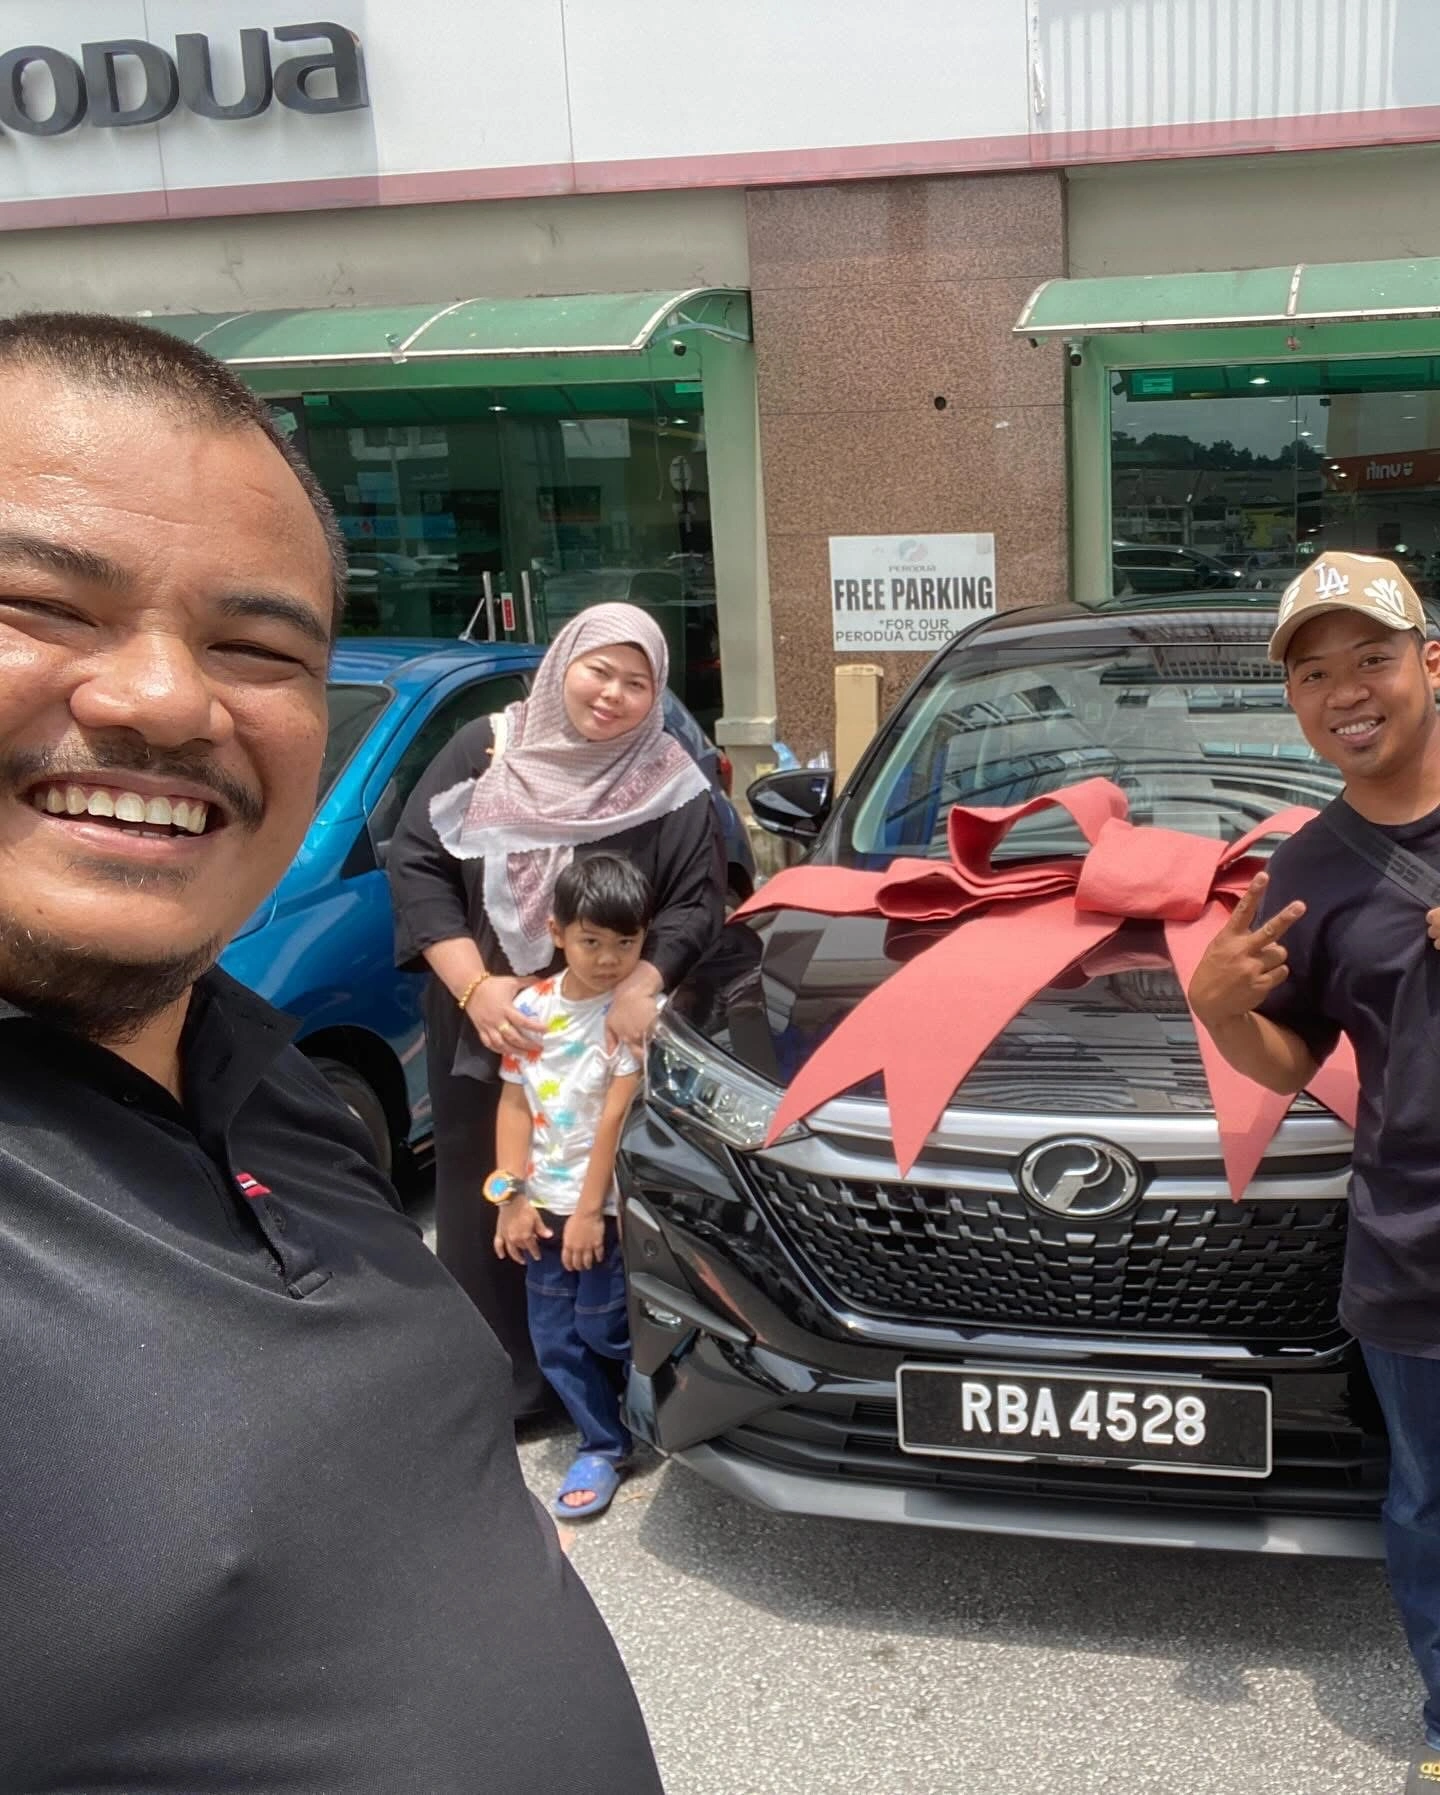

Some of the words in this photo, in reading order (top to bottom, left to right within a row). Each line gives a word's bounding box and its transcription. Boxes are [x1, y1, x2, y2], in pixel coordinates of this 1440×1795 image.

[0, 21, 369, 137] ODUa
[834, 578, 886, 611] FREE
[891, 576, 993, 610] PARKING
[1315, 562, 1350, 600] LA
[836, 631, 904, 642] PERODUA
[919, 618, 949, 630] OUR
[961, 1382, 1060, 1438] RBA
[1069, 1390, 1206, 1446] 4528
